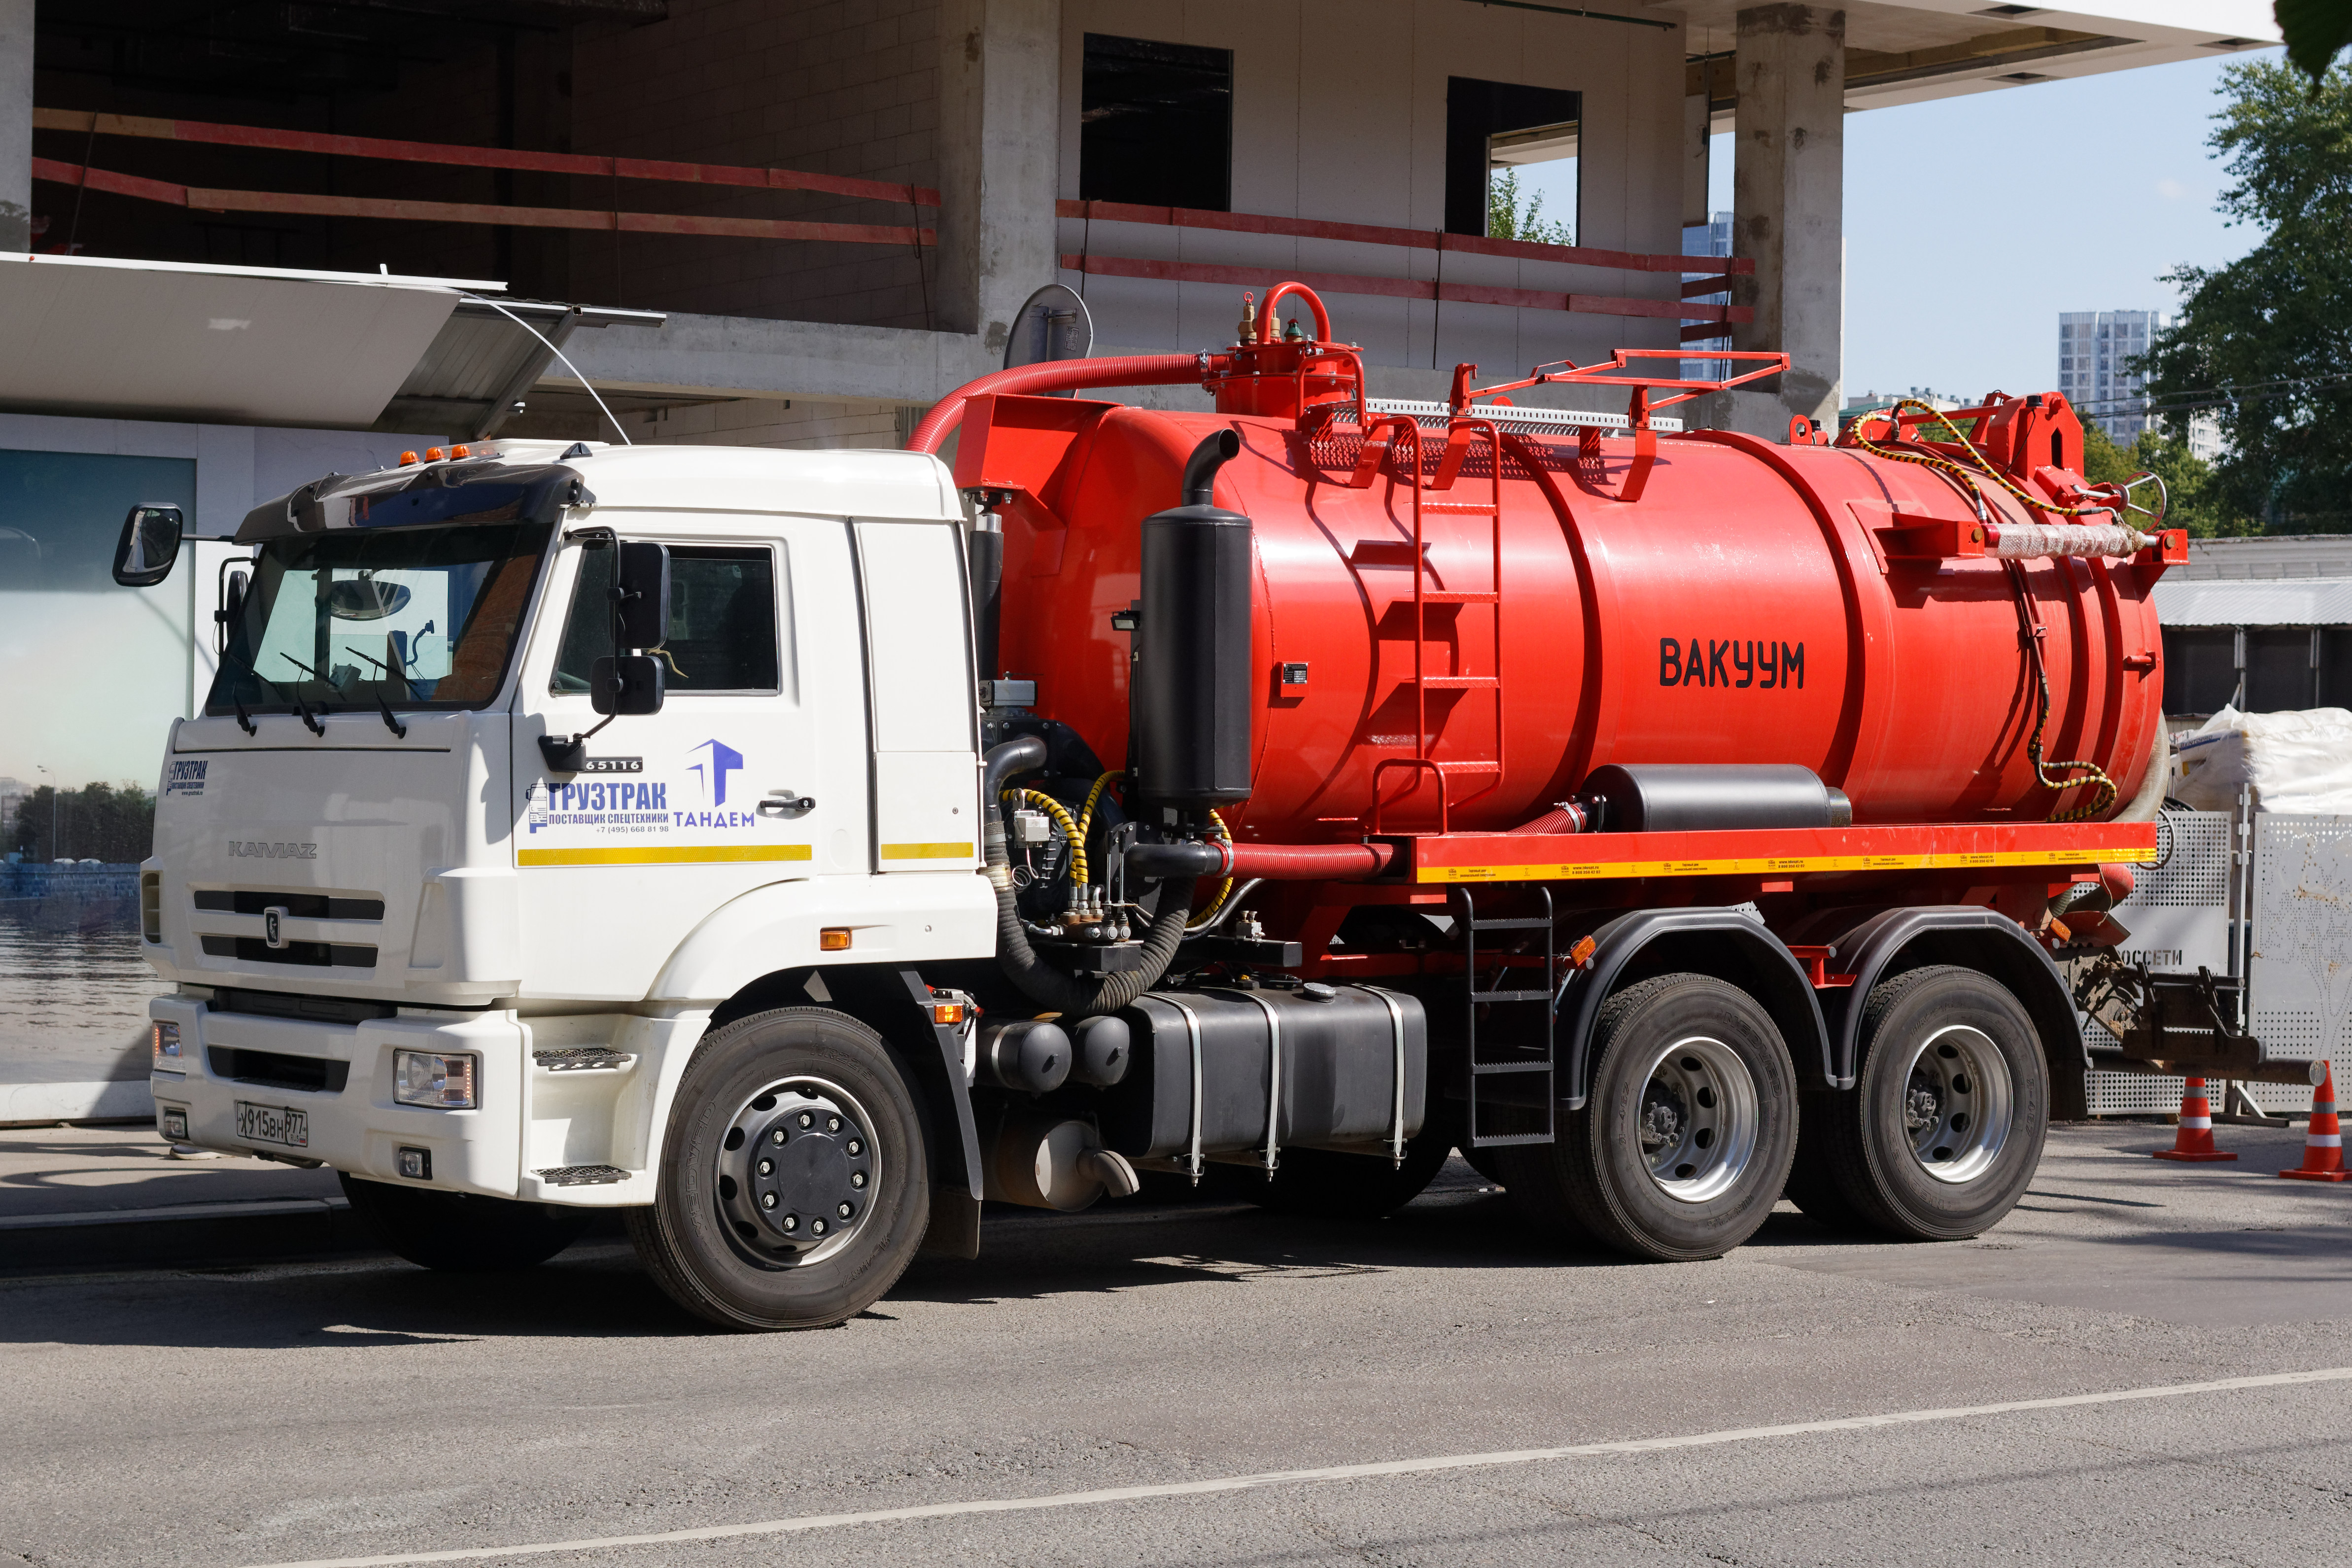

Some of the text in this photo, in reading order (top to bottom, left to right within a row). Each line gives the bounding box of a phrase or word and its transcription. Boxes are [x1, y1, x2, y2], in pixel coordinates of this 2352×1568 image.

[1660, 638, 1804, 689] ВАКУУМ
[173, 761, 208, 780] ГРУЗТРАК
[586, 761, 639, 770] 65116
[549, 783, 666, 811] ГРУЗТРАК
[549, 813, 669, 825] ПОСТАВЩИК СПЕЦТЕХНИКИ
[673, 812, 755, 829] ТАНДЕМ
[228, 841, 317, 859] KAMAZ
[2118, 949, 2182, 966] ОССЕТИ
[685, 1101, 716, 1238] MEDVED
